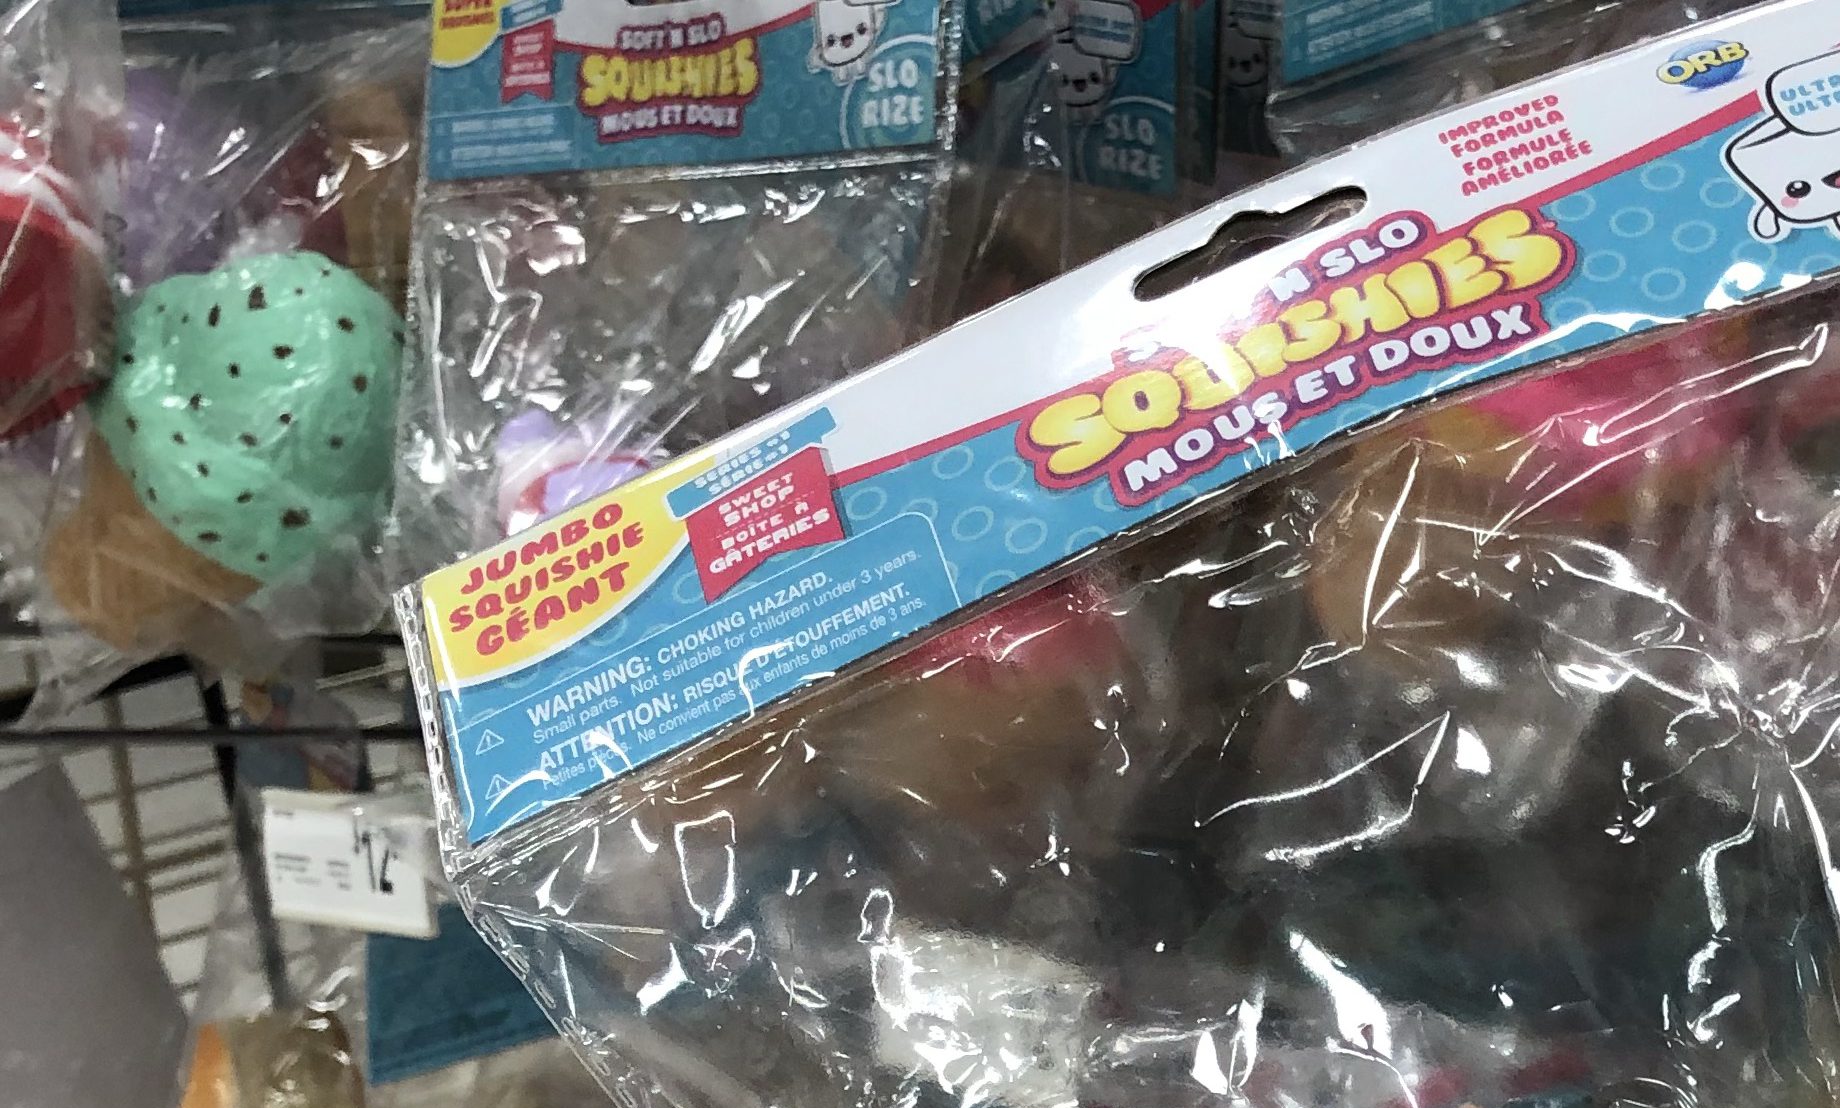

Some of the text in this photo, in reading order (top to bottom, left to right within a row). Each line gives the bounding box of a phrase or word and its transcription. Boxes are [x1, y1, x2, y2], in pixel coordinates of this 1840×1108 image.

[869, 57, 918, 92] SLO
[1656, 40, 1749, 85] ORB
[861, 95, 924, 127] RIZE
[1104, 113, 1155, 146] SLO
[1438, 94, 1559, 145] IMPROVED
[1450, 109, 1565, 159] FORMULA
[1099, 145, 1161, 180] RIZE
[1461, 139, 1593, 196] AMÉLIORÉE
[1462, 127, 1573, 177] FORMULE
[1320, 218, 1420, 277] SLO
[1028, 209, 1563, 476] SQUISHIES
[1124, 303, 1534, 492] MOUS ET DOUX
[694, 446, 762, 489] SERIES
[718, 472, 793, 514] SWEET
[724, 485, 794, 527] SHOP
[461, 503, 624, 595] JUMBO
[709, 508, 831, 574] GÂTERIES
[450, 522, 644, 632] SQUISHIE
[476, 561, 630, 656] GÉANT
[527, 572, 833, 727] WARNING: CHOKING HAZARD.
[533, 549, 921, 744] Small parts. Not suitable for children under 3 years.
[637, 727, 656, 746] Ne
[659, 700, 711, 734] convient
[713, 689, 737, 712] pas
[764, 654, 810, 682] enfants
[811, 640, 828, 659] de
[830, 624, 868, 650] moins
[869, 615, 886, 632] de
[889, 607, 898, 623] 3
[900, 596, 927, 617] ans.
[540, 692, 679, 773] ATTENTION:
[683, 661, 753, 704] RISQUE
